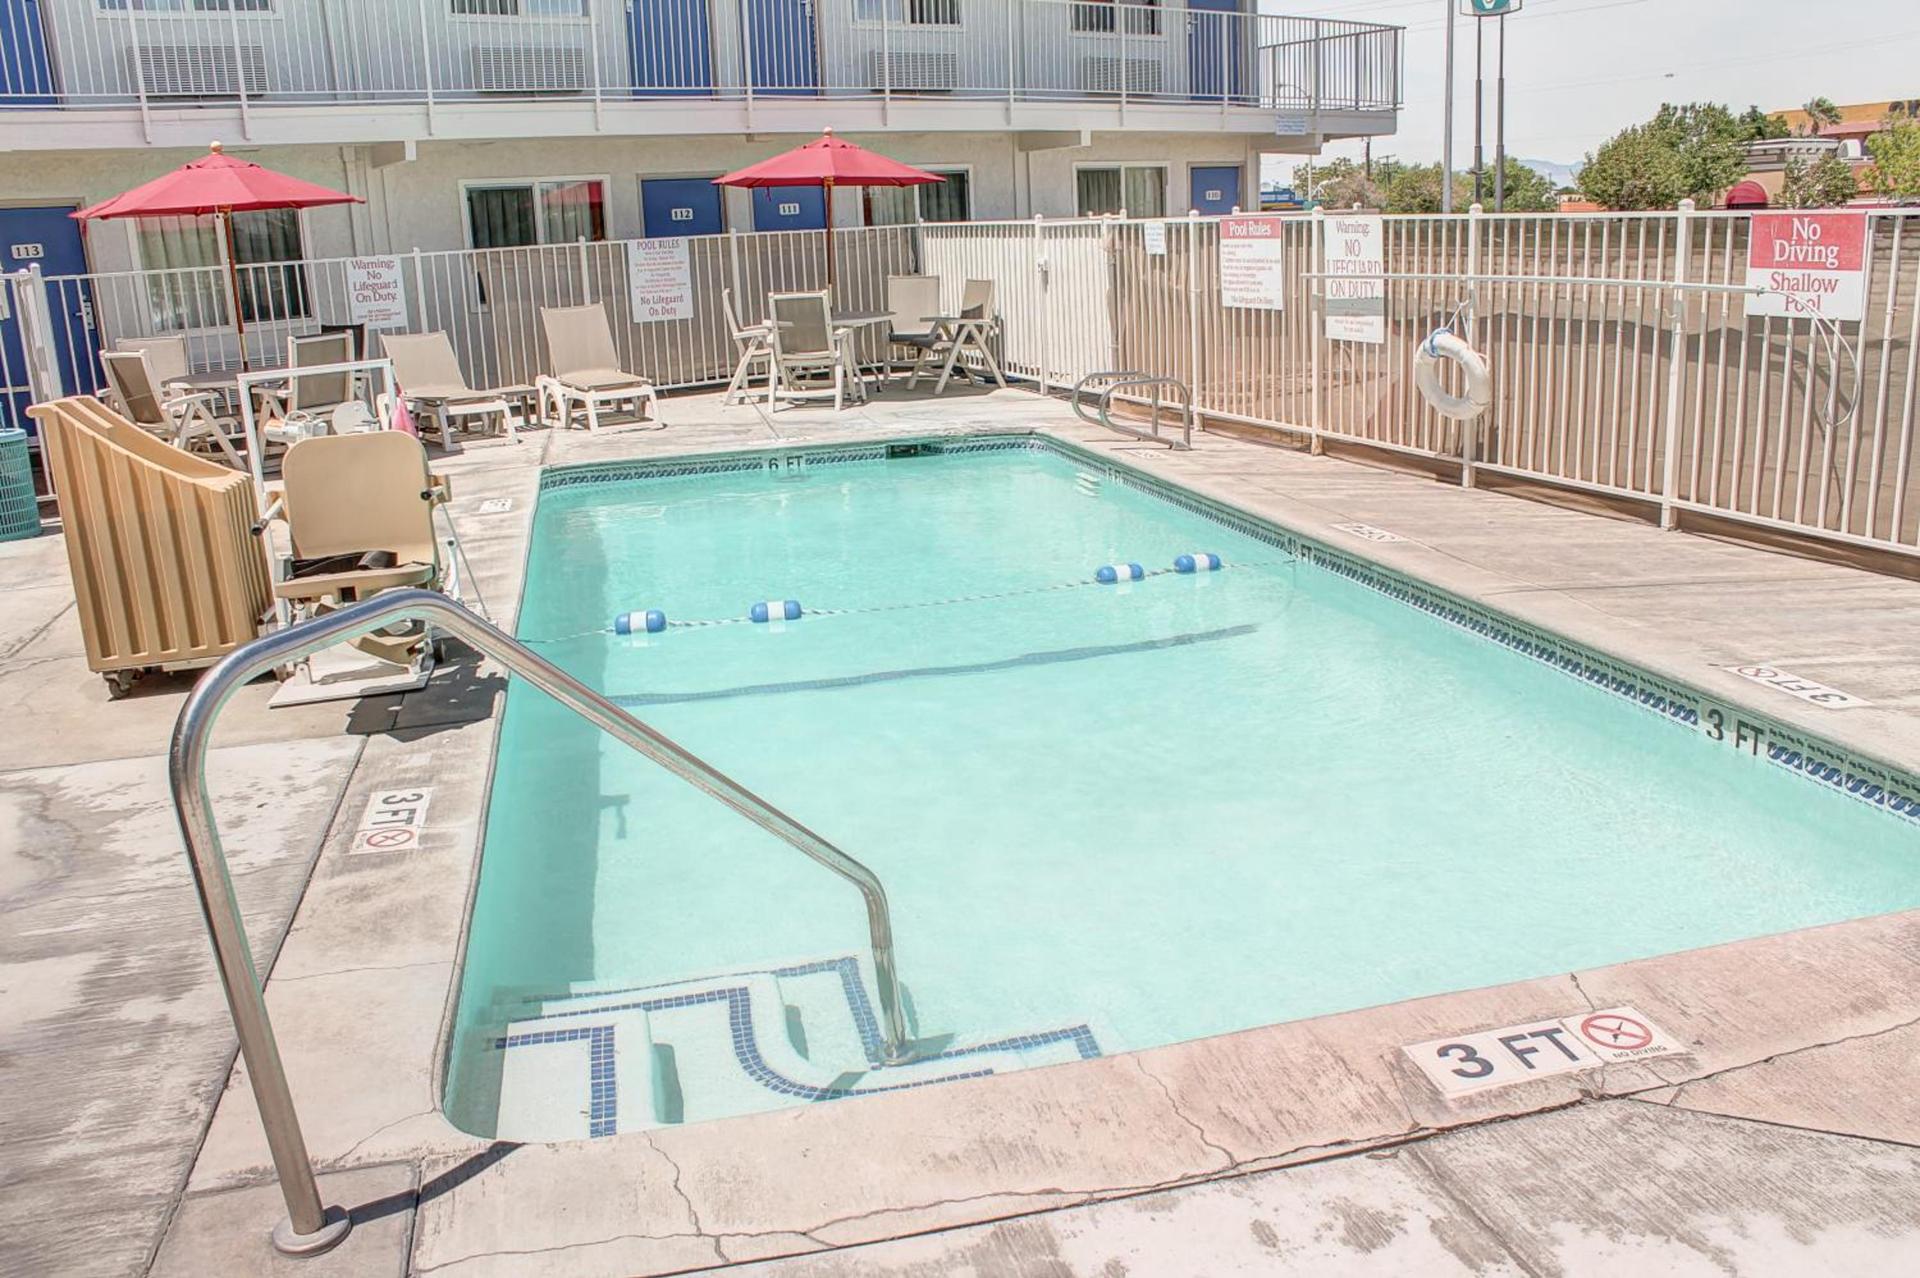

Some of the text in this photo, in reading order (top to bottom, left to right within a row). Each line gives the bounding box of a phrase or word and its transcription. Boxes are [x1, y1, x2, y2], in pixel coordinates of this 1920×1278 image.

[674, 210, 691, 219] 112
[782, 205, 797, 213] 111
[1229, 221, 1271, 237] Pool Rules
[1792, 218, 1821, 240] No
[16, 245, 40, 256] 113
[637, 241, 657, 250] POOL
[1345, 240, 1361, 256] NO
[1774, 240, 1839, 269] Diving
[367, 271, 382, 280] No
[1770, 271, 1839, 293] Shallow
[353, 280, 398, 293] Lifeguard
[1331, 280, 1345, 297] ON
[355, 293, 371, 303] On
[640, 293, 684, 305] No Lifeguard
[1784, 294, 1822, 313] Pool
[648, 306, 677, 316] On Duty
[768, 455, 803, 470] 6 FT
[1809, 693, 1848, 702] 3
[1706, 708, 1764, 756] 3 FT
[371, 793, 424, 825] 3 FT
[1437, 1027, 1580, 1079] 3 FT
[1630, 1045, 1668, 1056] DIVING
